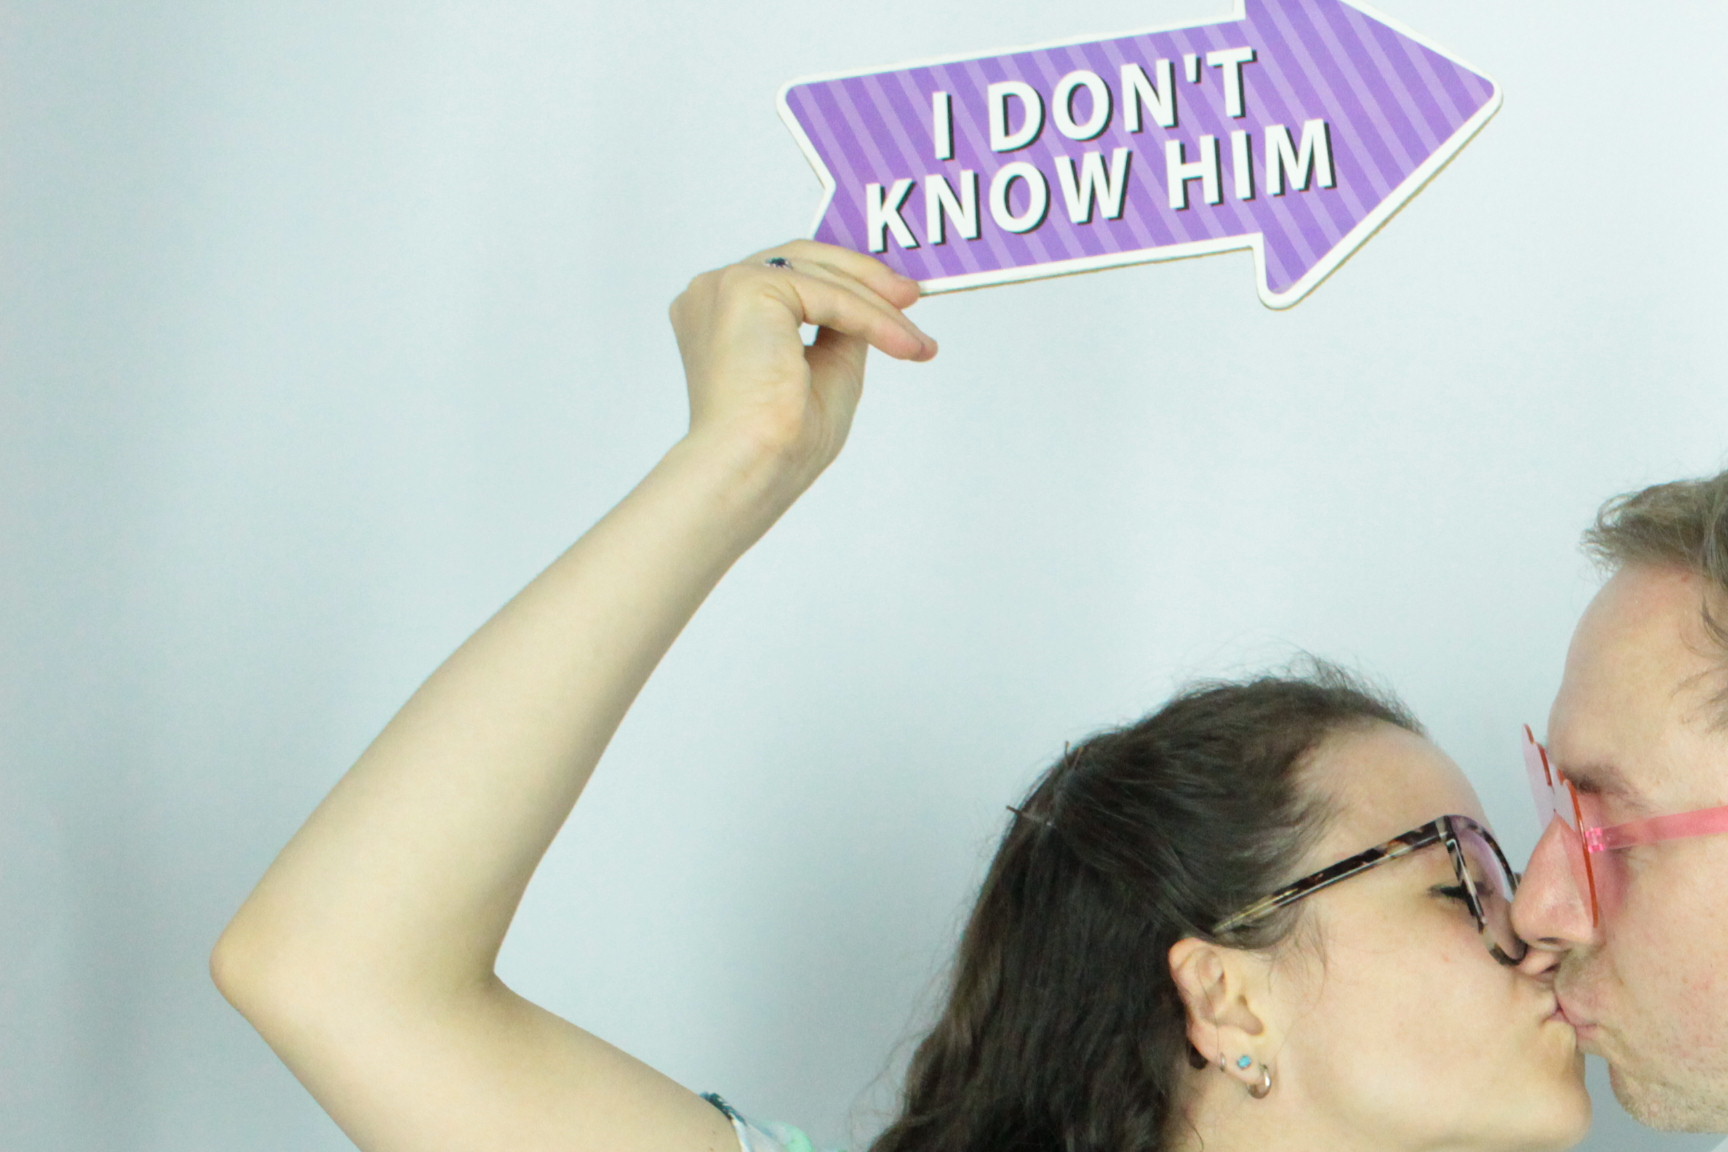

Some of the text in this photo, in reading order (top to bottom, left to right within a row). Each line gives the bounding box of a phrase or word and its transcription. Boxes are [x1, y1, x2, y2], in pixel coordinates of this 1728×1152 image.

[931, 46, 1258, 160] I DON'T
[866, 118, 1338, 253] KNOW HIM
